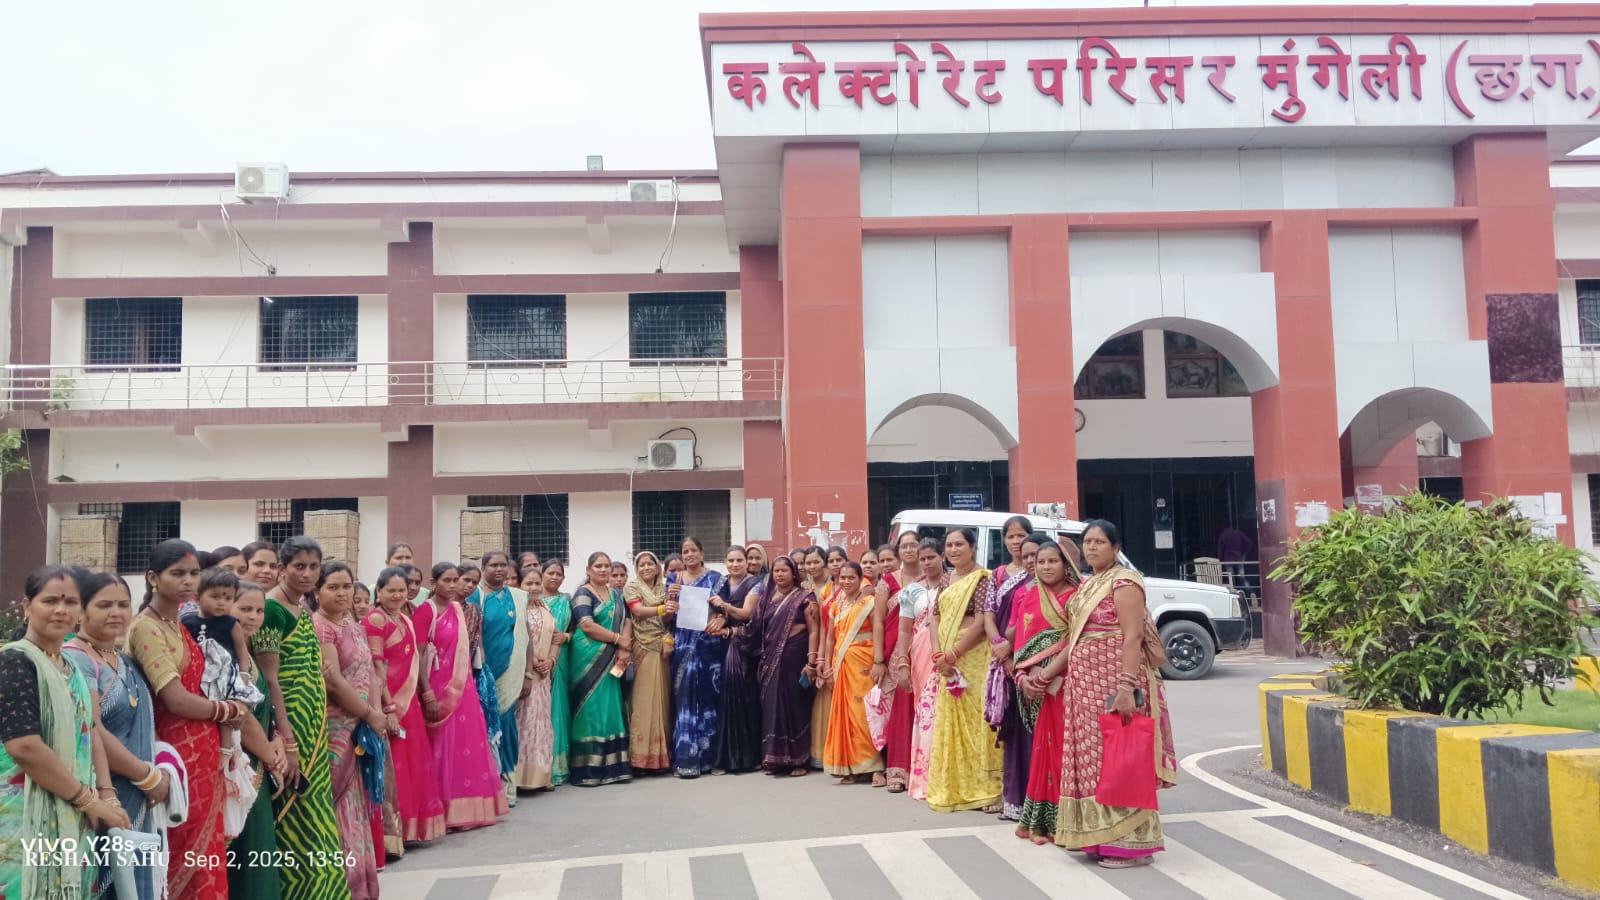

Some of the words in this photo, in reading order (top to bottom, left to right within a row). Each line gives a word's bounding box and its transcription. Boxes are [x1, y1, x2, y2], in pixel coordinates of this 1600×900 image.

[722, 43, 1006, 110] कलेक्टोरेट
[1027, 37, 1236, 106] परिसर
[1258, 34, 1427, 123] मुंगेली
